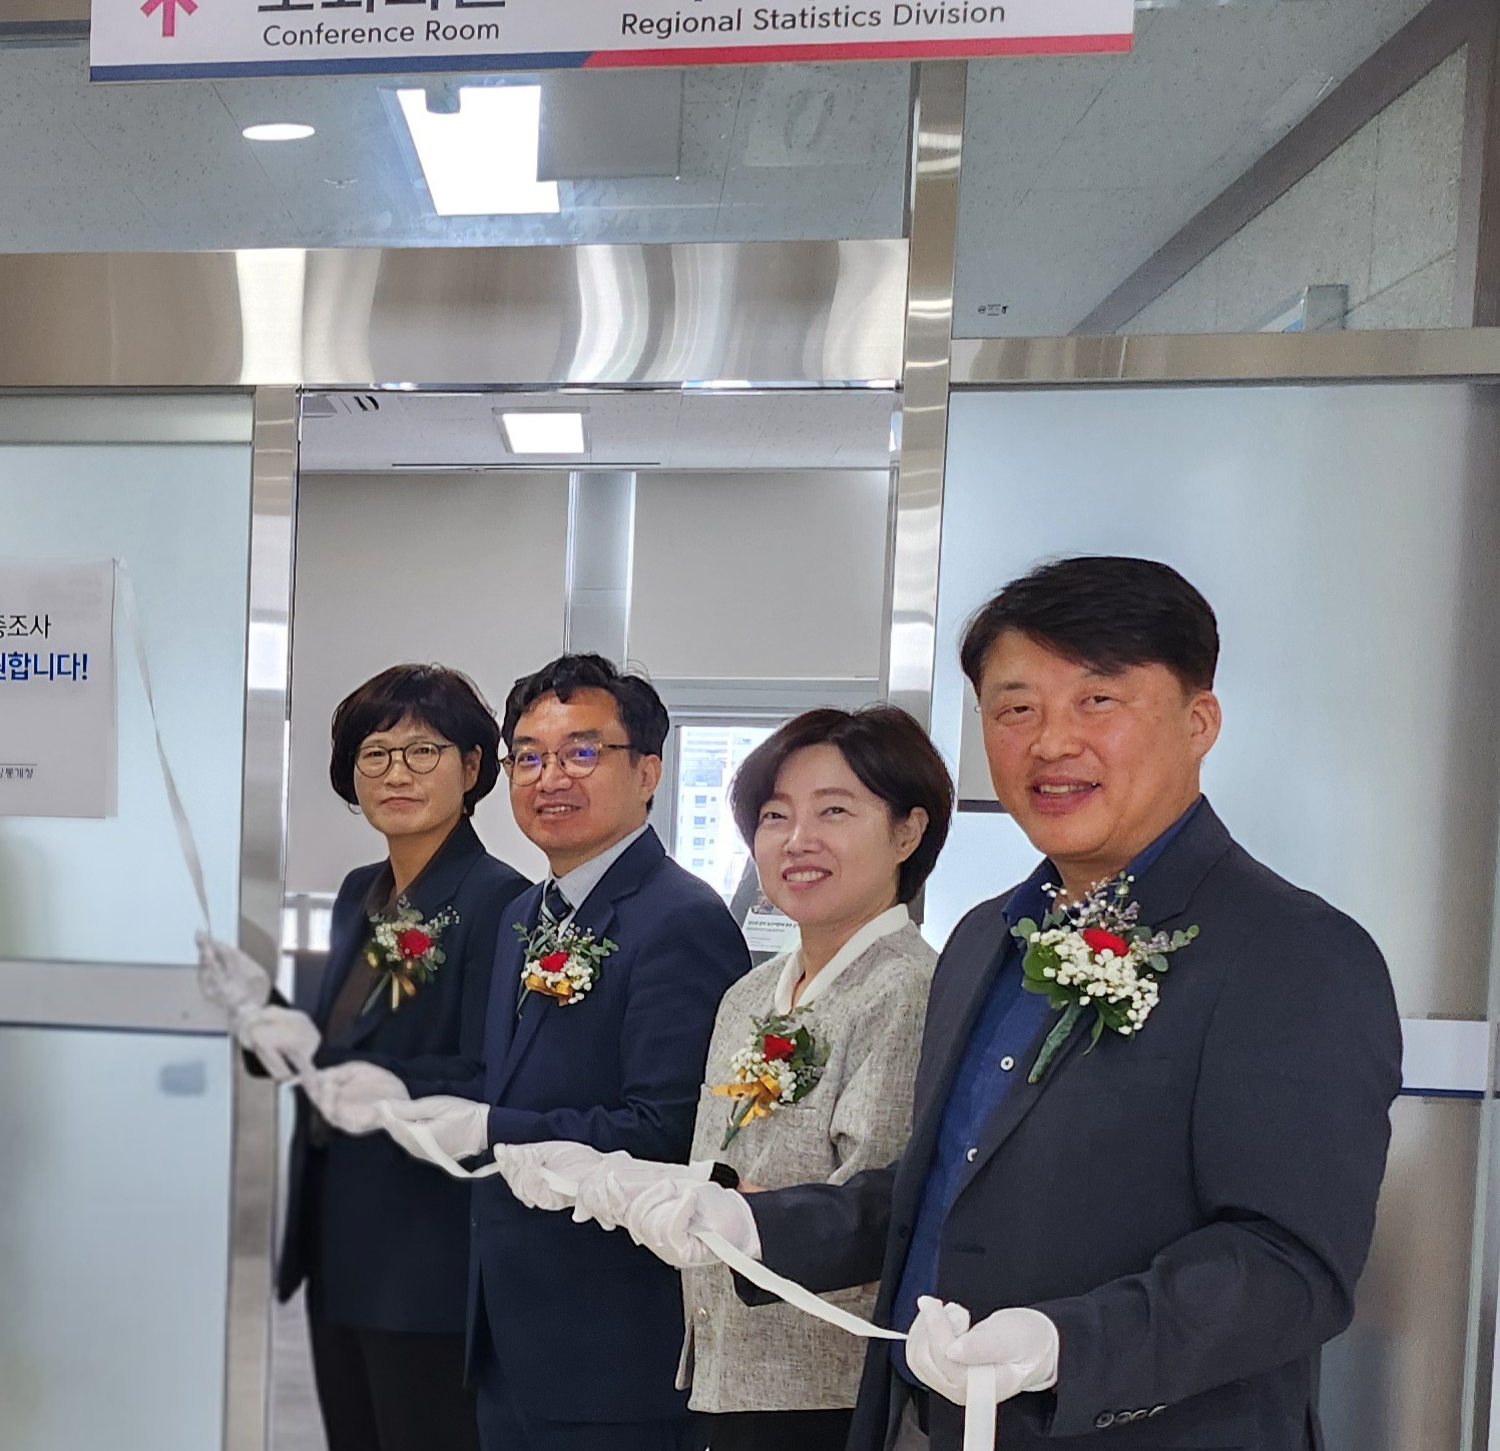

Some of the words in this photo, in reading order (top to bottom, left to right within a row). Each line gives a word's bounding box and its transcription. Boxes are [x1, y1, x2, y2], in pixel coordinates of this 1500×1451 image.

[263, 22, 415, 46] Conference
[425, 20, 499, 42] Room
[621, 8, 742, 39] Regional
[752, 4, 882, 30] Statistics
[893, 3, 1005, 26] Division
